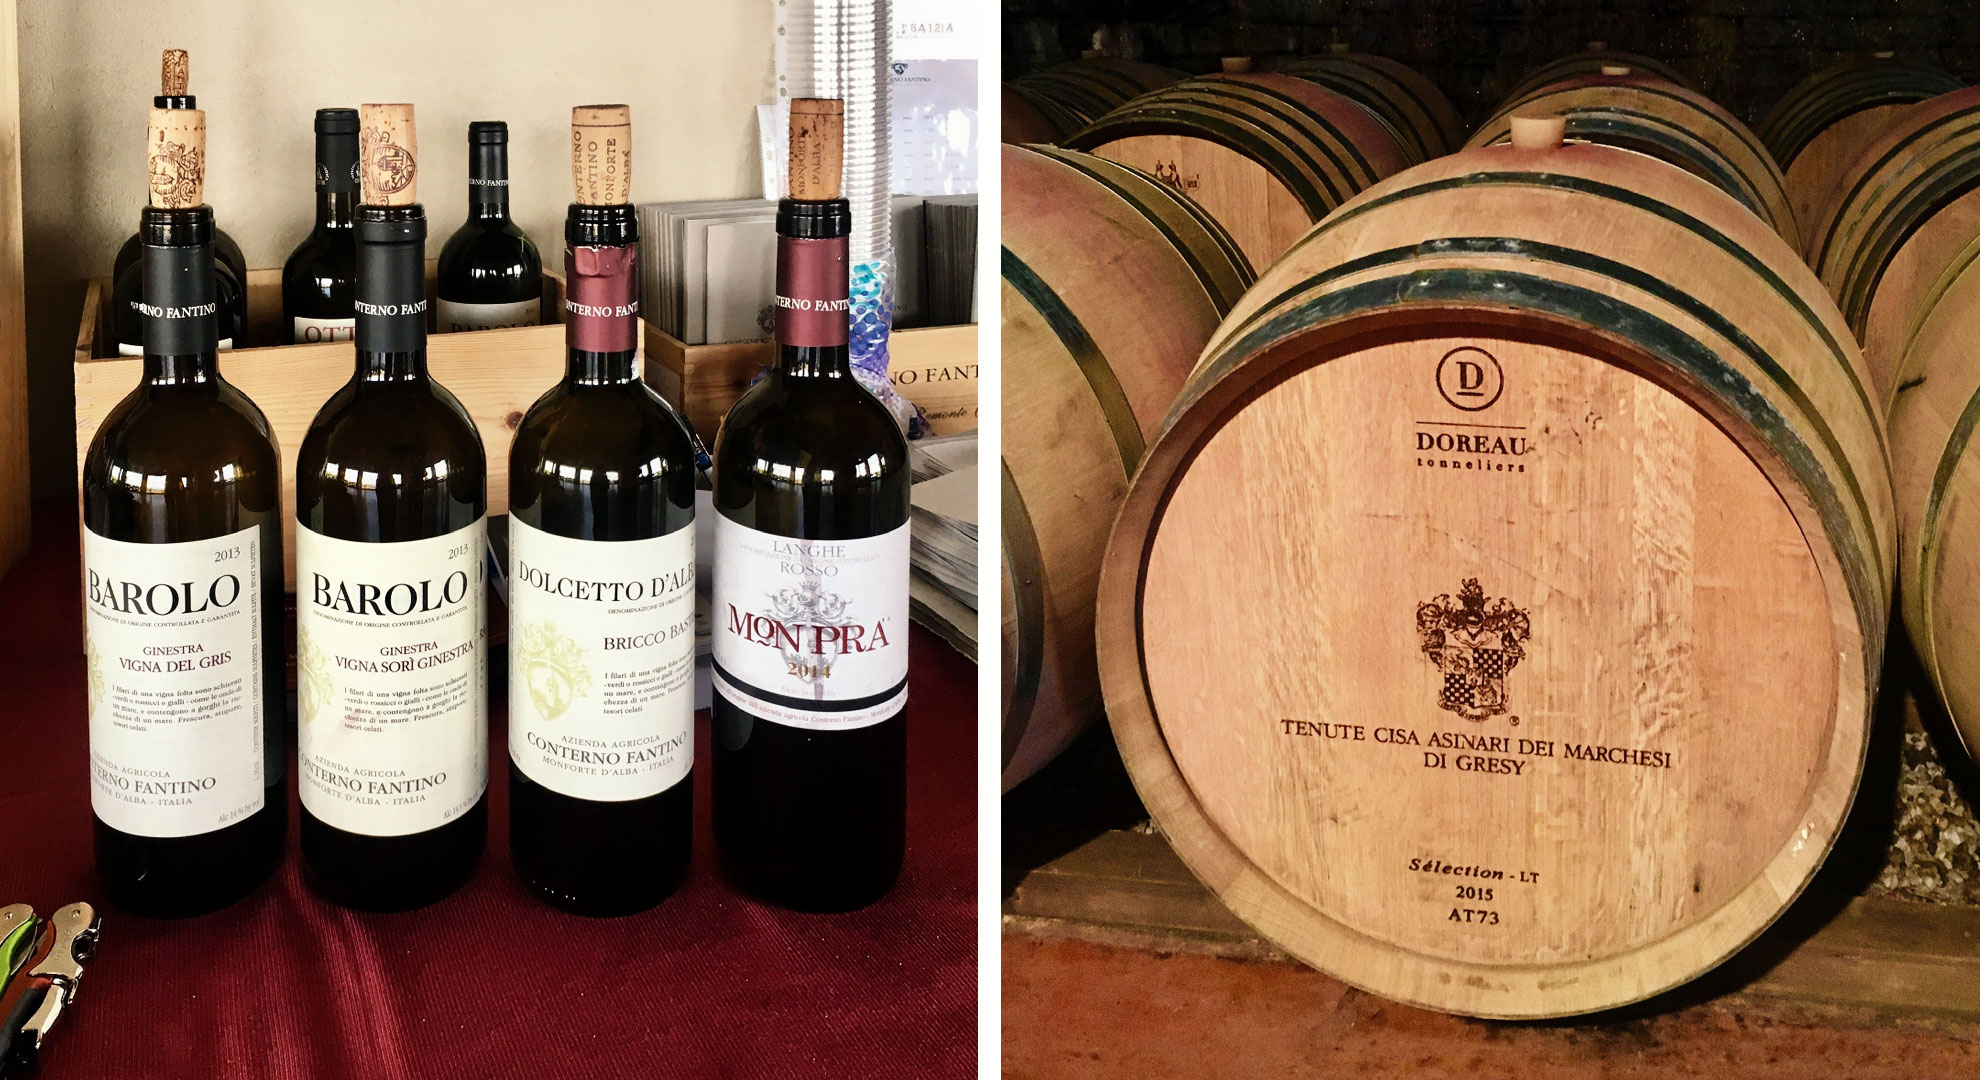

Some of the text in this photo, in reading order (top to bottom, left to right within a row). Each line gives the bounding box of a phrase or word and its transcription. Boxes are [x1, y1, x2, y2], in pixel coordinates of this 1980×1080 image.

[166, 302, 216, 319] FANTINO
[1456, 361, 1484, 390] D
[1416, 432, 1527, 456] DOREAU
[1417, 457, 1525, 473] tonneliers
[214, 546, 241, 563] 2013
[448, 543, 469, 560] 2013
[773, 540, 846, 558] LANGHE
[780, 560, 839, 578] ROSSO
[519, 560, 645, 602] DOLCETTO
[88, 567, 241, 616] BAROLO
[312, 570, 468, 616] BAROLO
[153, 619, 200, 627] CONTROLLATA
[206, 609, 241, 623] GARANTITA
[391, 617, 435, 628] CONTROLLATA
[441, 605, 468, 619] GARANTITA
[380, 640, 439, 657] GINESTRA
[603, 630, 666, 650] BRICCO
[142, 643, 204, 656] GINESTRA
[335, 640, 474, 673] VIGNA SORÌ GINESTRA
[119, 651, 232, 673] VIGNA DEL GRIS
[787, 661, 831, 679] 2014
[155, 691, 174, 699] vigna
[392, 690, 411, 698] vigna
[603, 698, 628, 706] chezza
[527, 730, 687, 765] CONTERNO FANTINO
[561, 734, 661, 749] AZIENDA AGRICOLA
[1281, 719, 1672, 769] TENUTE CISA ASINARI DEI MARCHESI
[121, 767, 171, 778] AGRICOLA
[315, 754, 406, 778] AZIENDA AGRICOLA
[542, 754, 674, 776] MONFORTE D'ALBA ITALIA
[1423, 752, 1526, 775] DI GRESY
[134, 776, 217, 795] FANTINO
[368, 771, 447, 795] FANTINO
[115, 790, 193, 806] D'ALBA ITALIA
[345, 794, 381, 806] D'ALBA
[393, 794, 426, 805] ITALIA
[1408, 857, 1540, 884] Sélection LT
[1455, 885, 1494, 901] 2015
[1448, 908, 1500, 926] AT73
